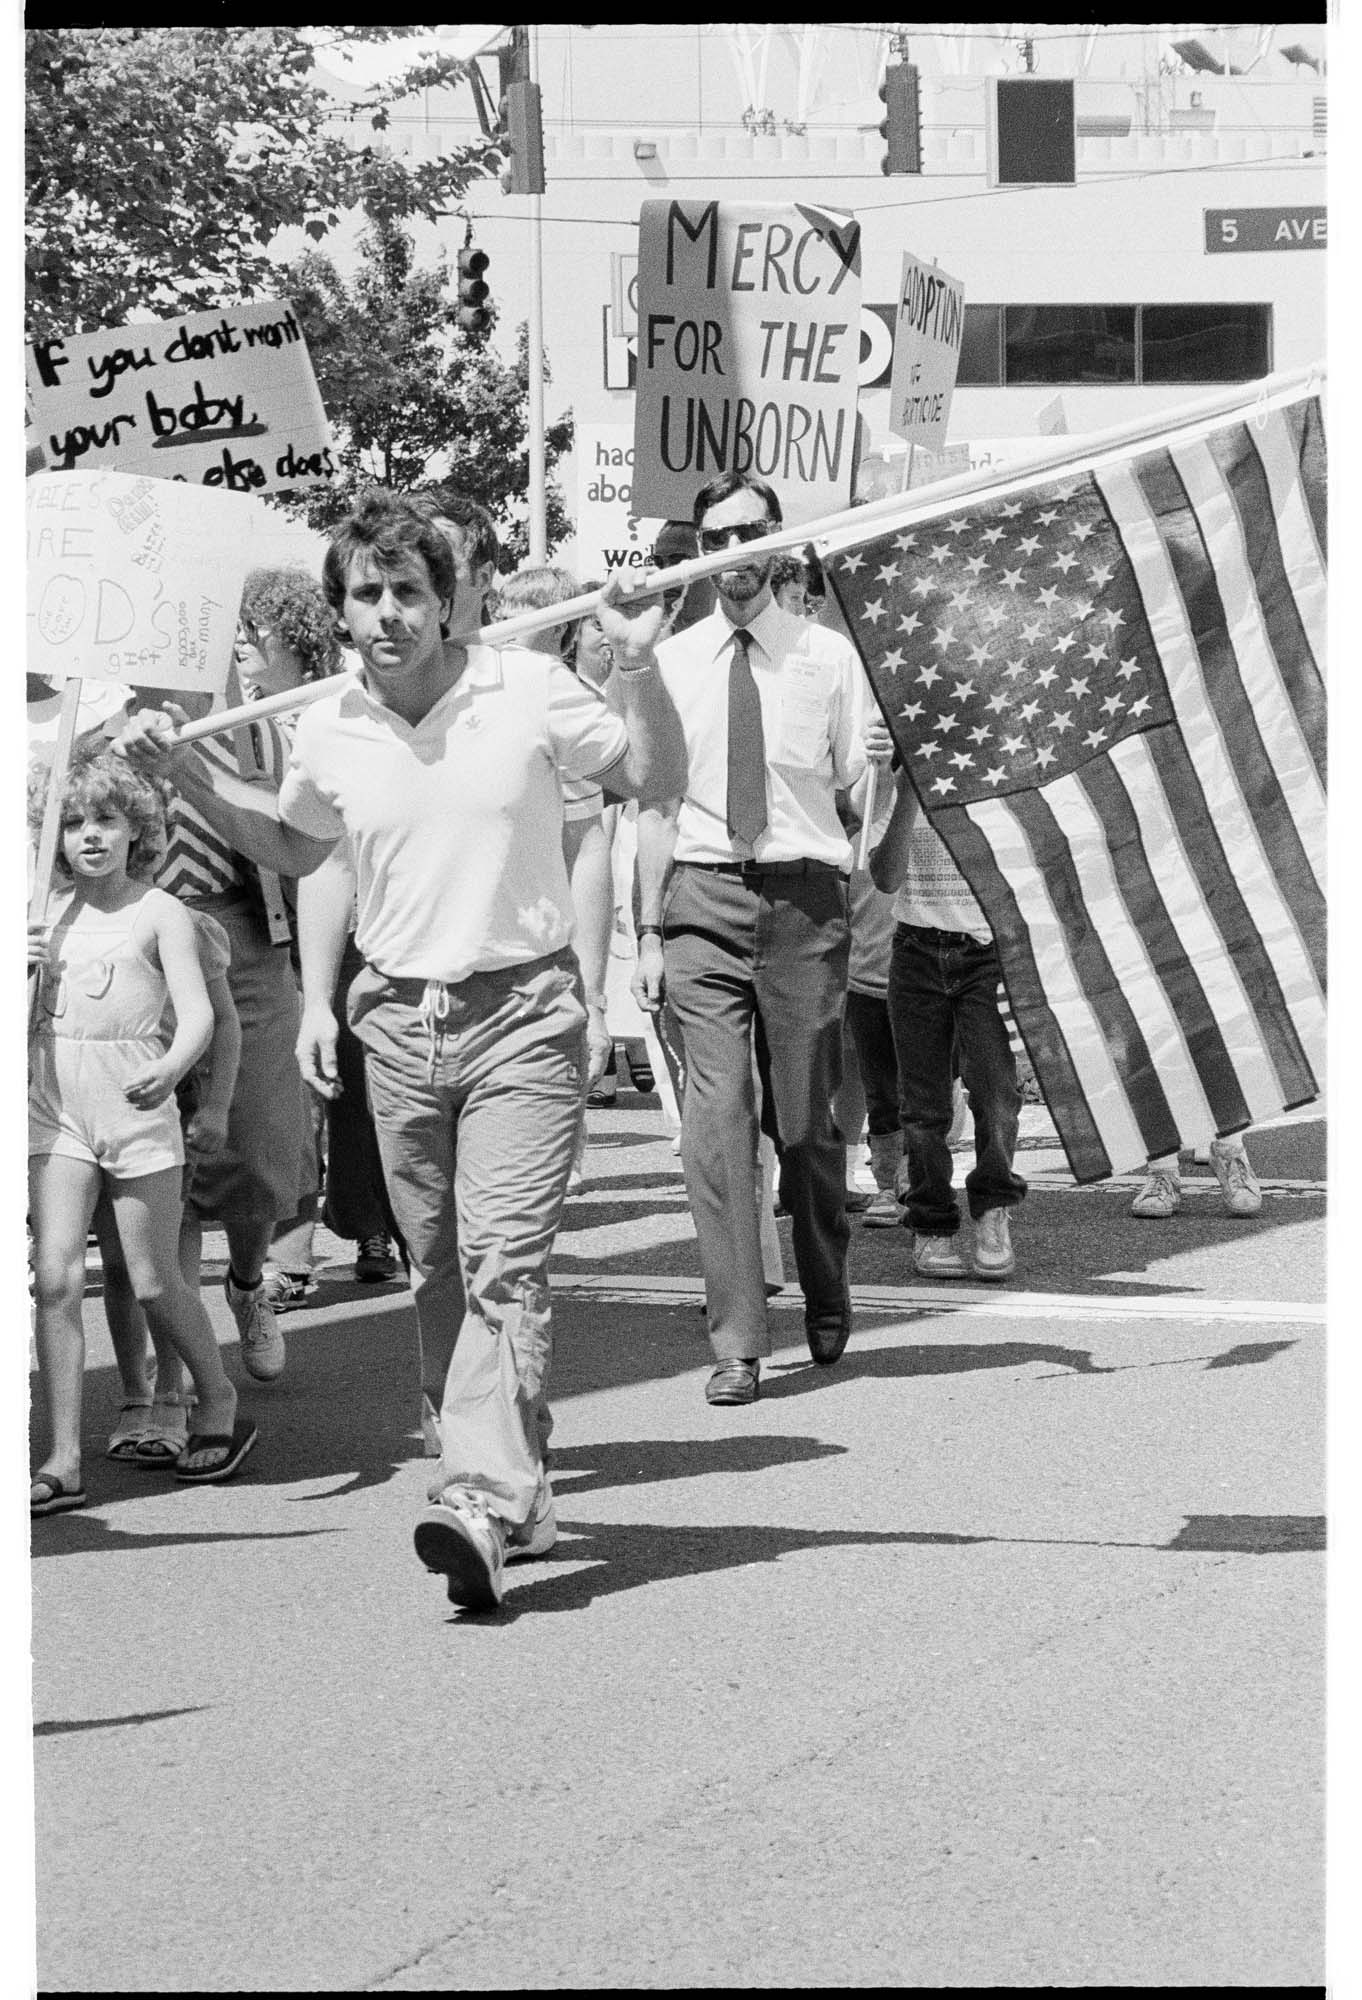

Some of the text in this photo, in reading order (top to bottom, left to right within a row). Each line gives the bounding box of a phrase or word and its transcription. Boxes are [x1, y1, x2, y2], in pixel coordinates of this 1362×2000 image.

[666, 200, 862, 295] MERCY
[1220, 218, 1327, 243] 5 AVE
[900, 266, 963, 350] ADOPTION
[88, 347, 157, 398] you
[647, 313, 726, 376] FOR
[760, 320, 848, 384] THE
[50, 414, 136, 471] your
[660, 395, 845, 484] UNBORN
[26, 527, 94, 559] RE
[26, 573, 177, 651] OD'S
[198, 594, 224, 644] many
